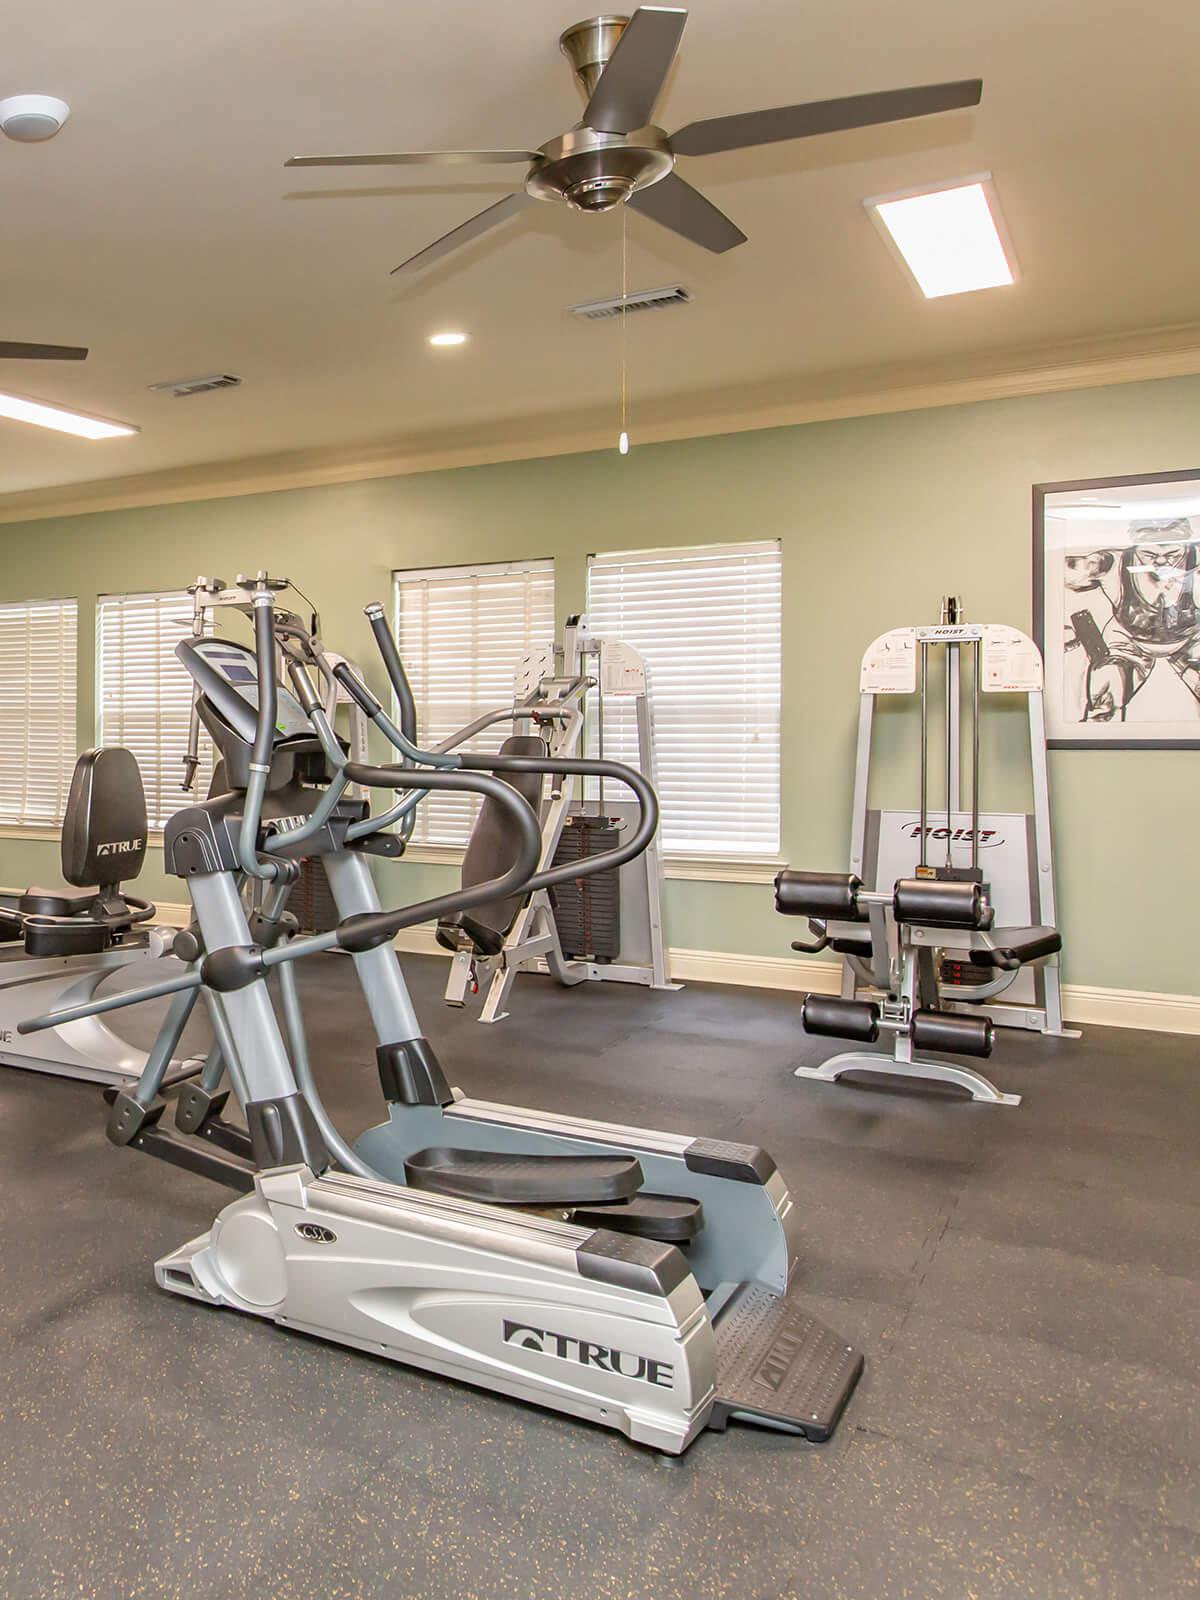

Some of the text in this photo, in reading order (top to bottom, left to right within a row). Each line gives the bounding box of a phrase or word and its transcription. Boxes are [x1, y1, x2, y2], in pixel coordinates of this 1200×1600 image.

[909, 827, 997, 842] HOIST
[111, 838, 142, 854] TRUE
[303, 1225, 327, 1241] CSX
[545, 1331, 673, 1389] TRUE
